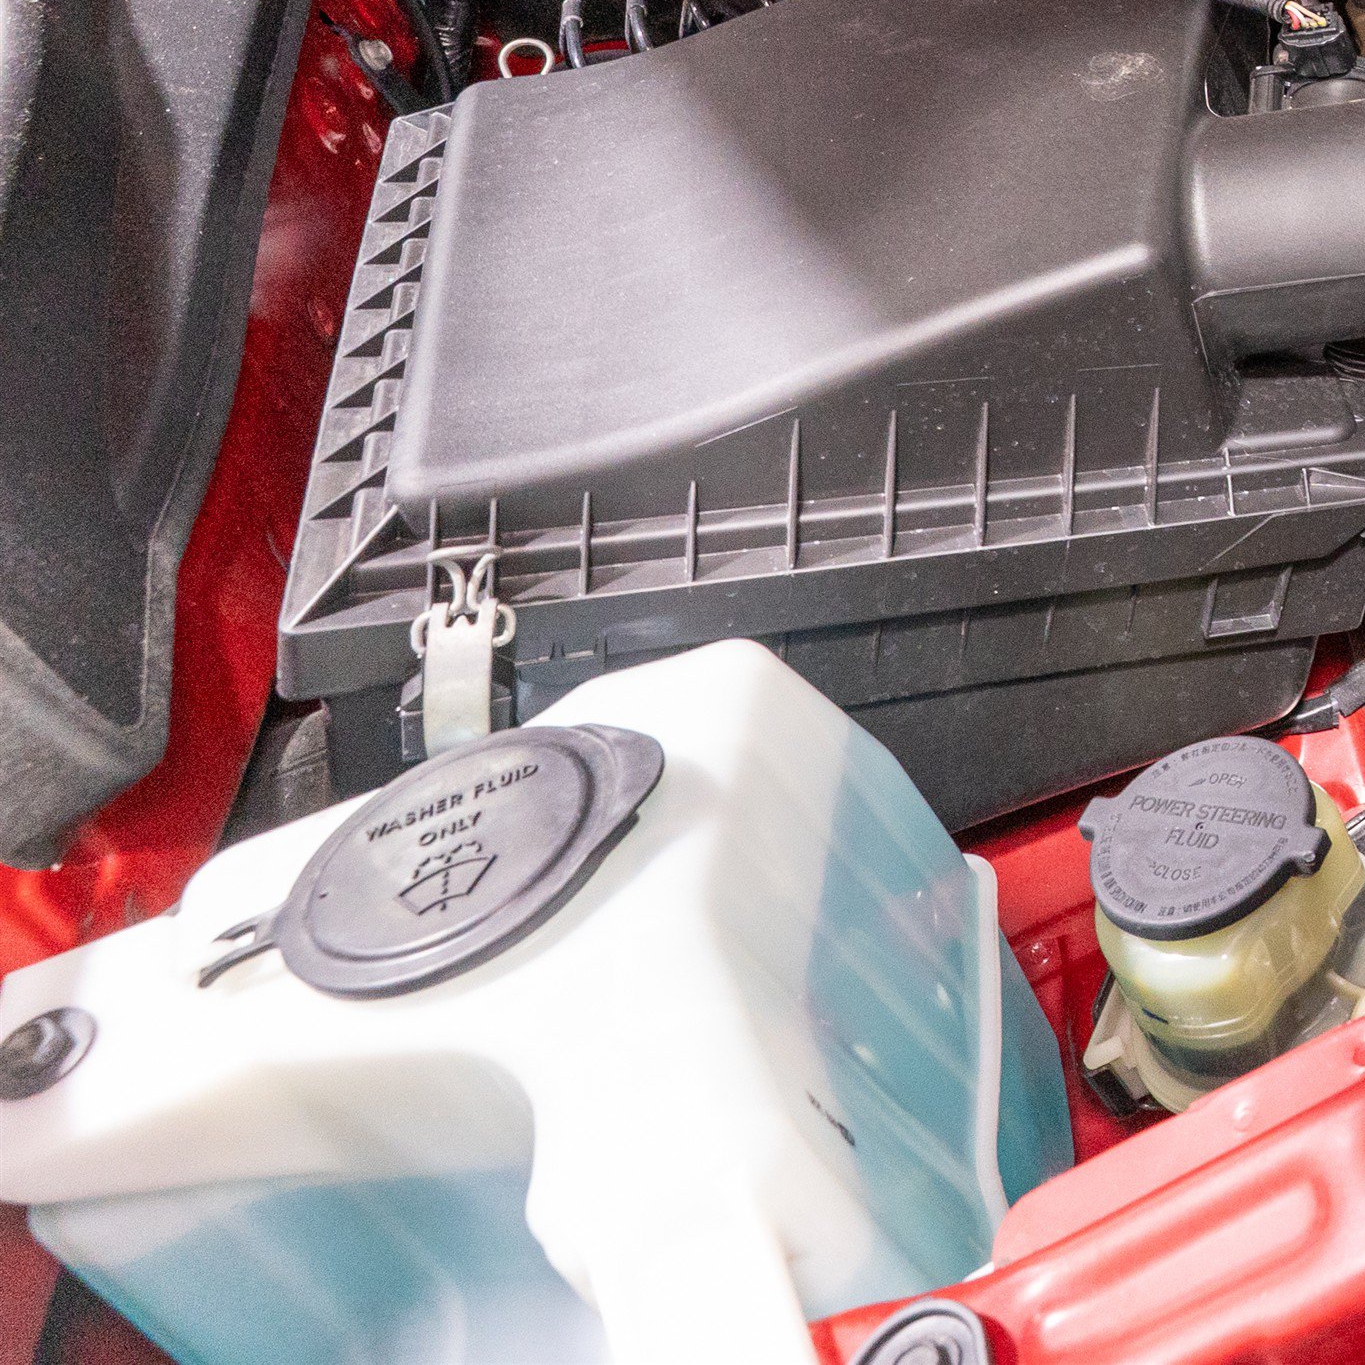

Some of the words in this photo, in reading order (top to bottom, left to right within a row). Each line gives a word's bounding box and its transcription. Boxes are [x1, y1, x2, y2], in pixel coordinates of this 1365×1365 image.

[1208, 772, 1248, 788] OPEN
[366, 793, 463, 842] WASHER
[473, 764, 539, 799] FLUID
[1128, 794, 1195, 819] POWER
[1194, 804, 1288, 831] STEERING
[418, 810, 482, 846] ONLY
[1164, 828, 1221, 850] FLUID
[1154, 864, 1202, 882] CLOSE
